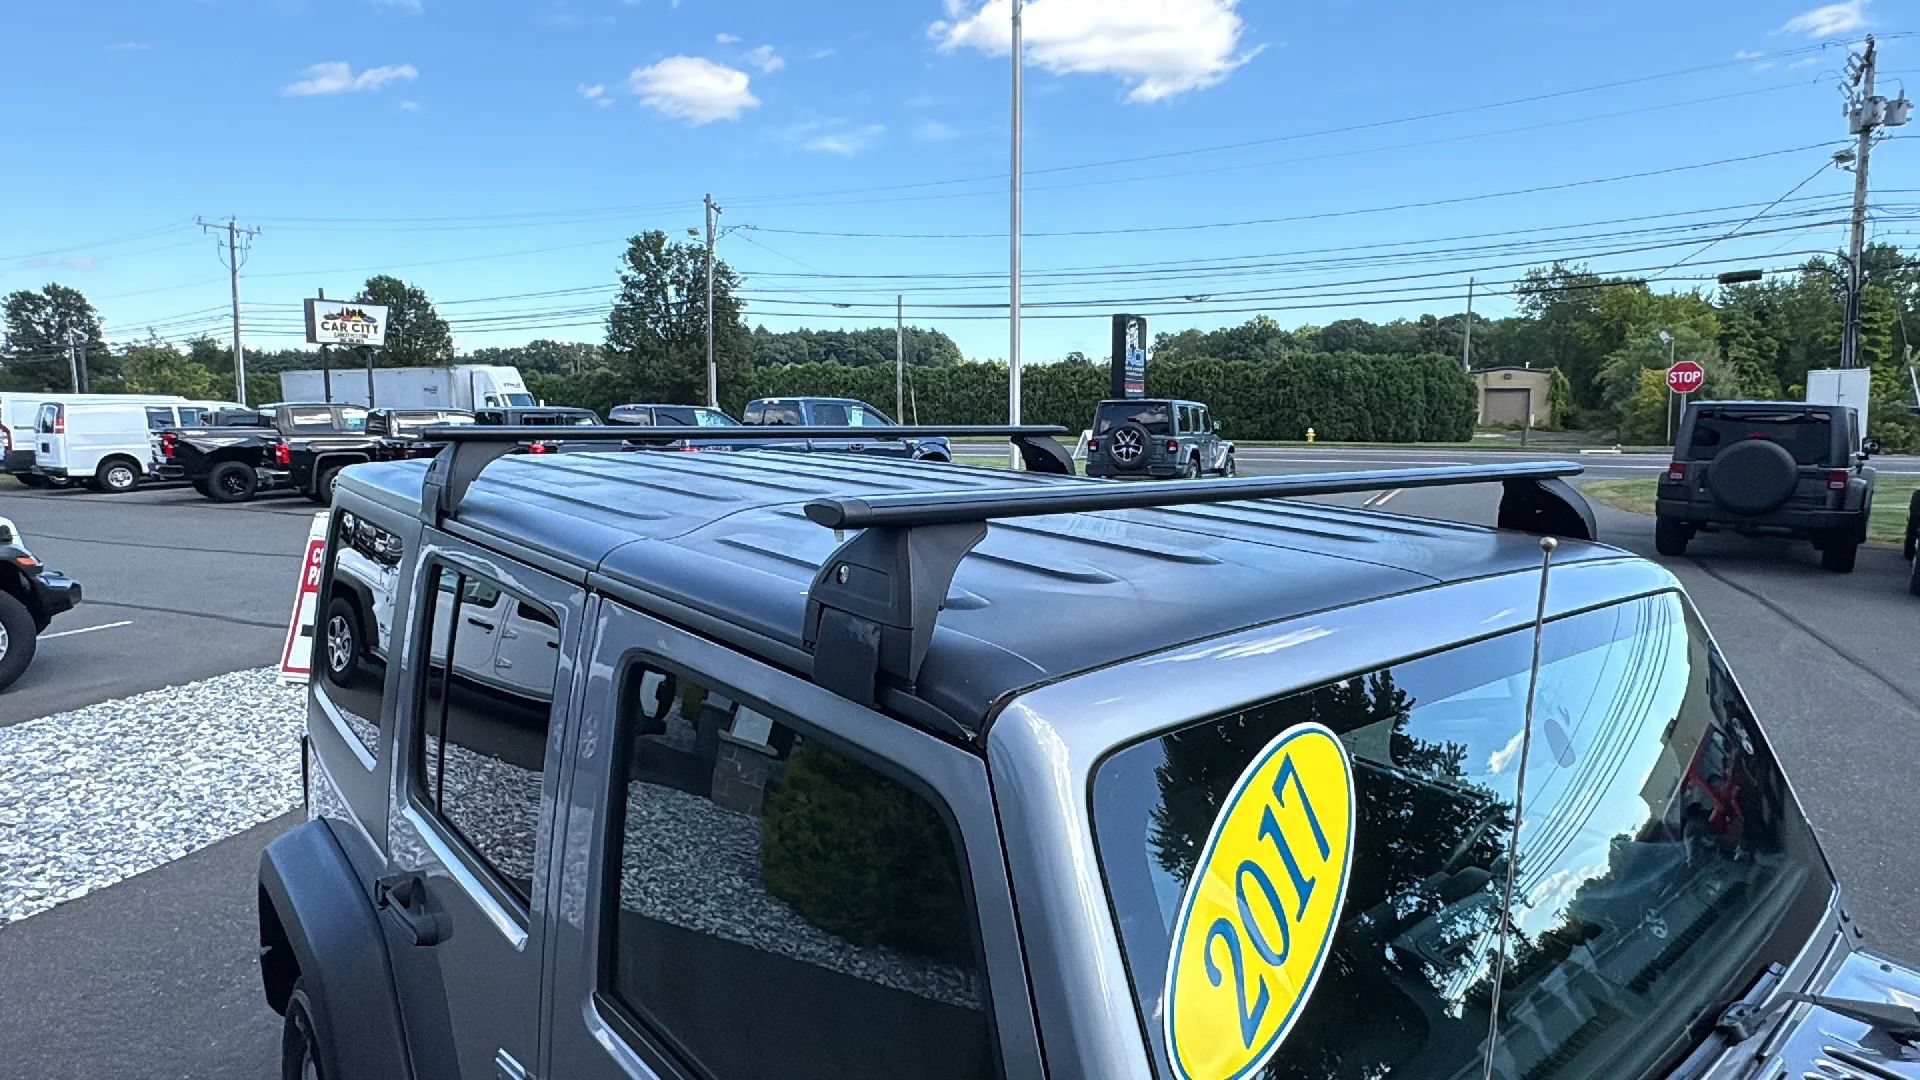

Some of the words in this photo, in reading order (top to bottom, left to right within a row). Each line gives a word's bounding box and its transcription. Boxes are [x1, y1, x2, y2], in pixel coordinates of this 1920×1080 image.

[321, 321, 348, 332] CAR
[352, 323, 379, 334] CITY
[1669, 371, 1701, 383] STOP
[1204, 752, 1330, 1050] 2017
